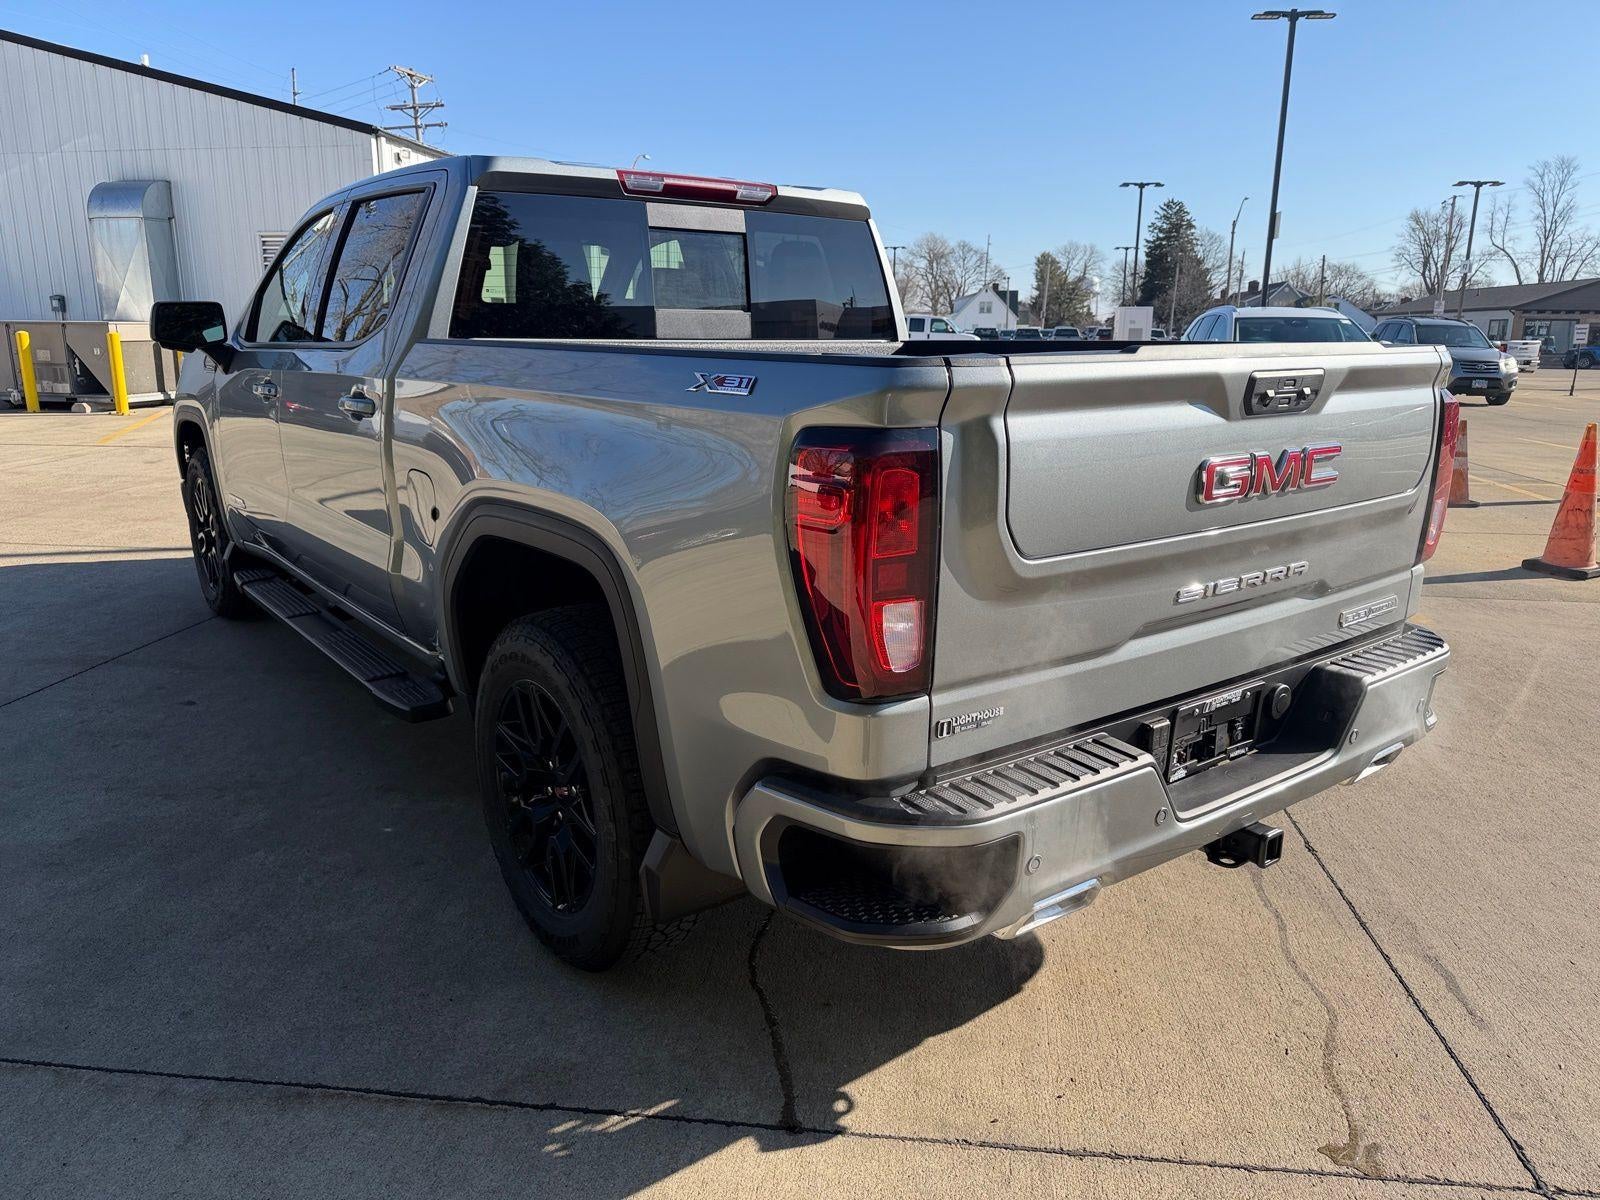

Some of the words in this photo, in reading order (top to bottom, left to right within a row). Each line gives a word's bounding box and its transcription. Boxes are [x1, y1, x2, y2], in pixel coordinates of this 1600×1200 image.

[1198, 441, 1343, 504] GMC
[1176, 560, 1310, 603] SIERRA
[952, 706, 1004, 726] LIGHTHOUSE
